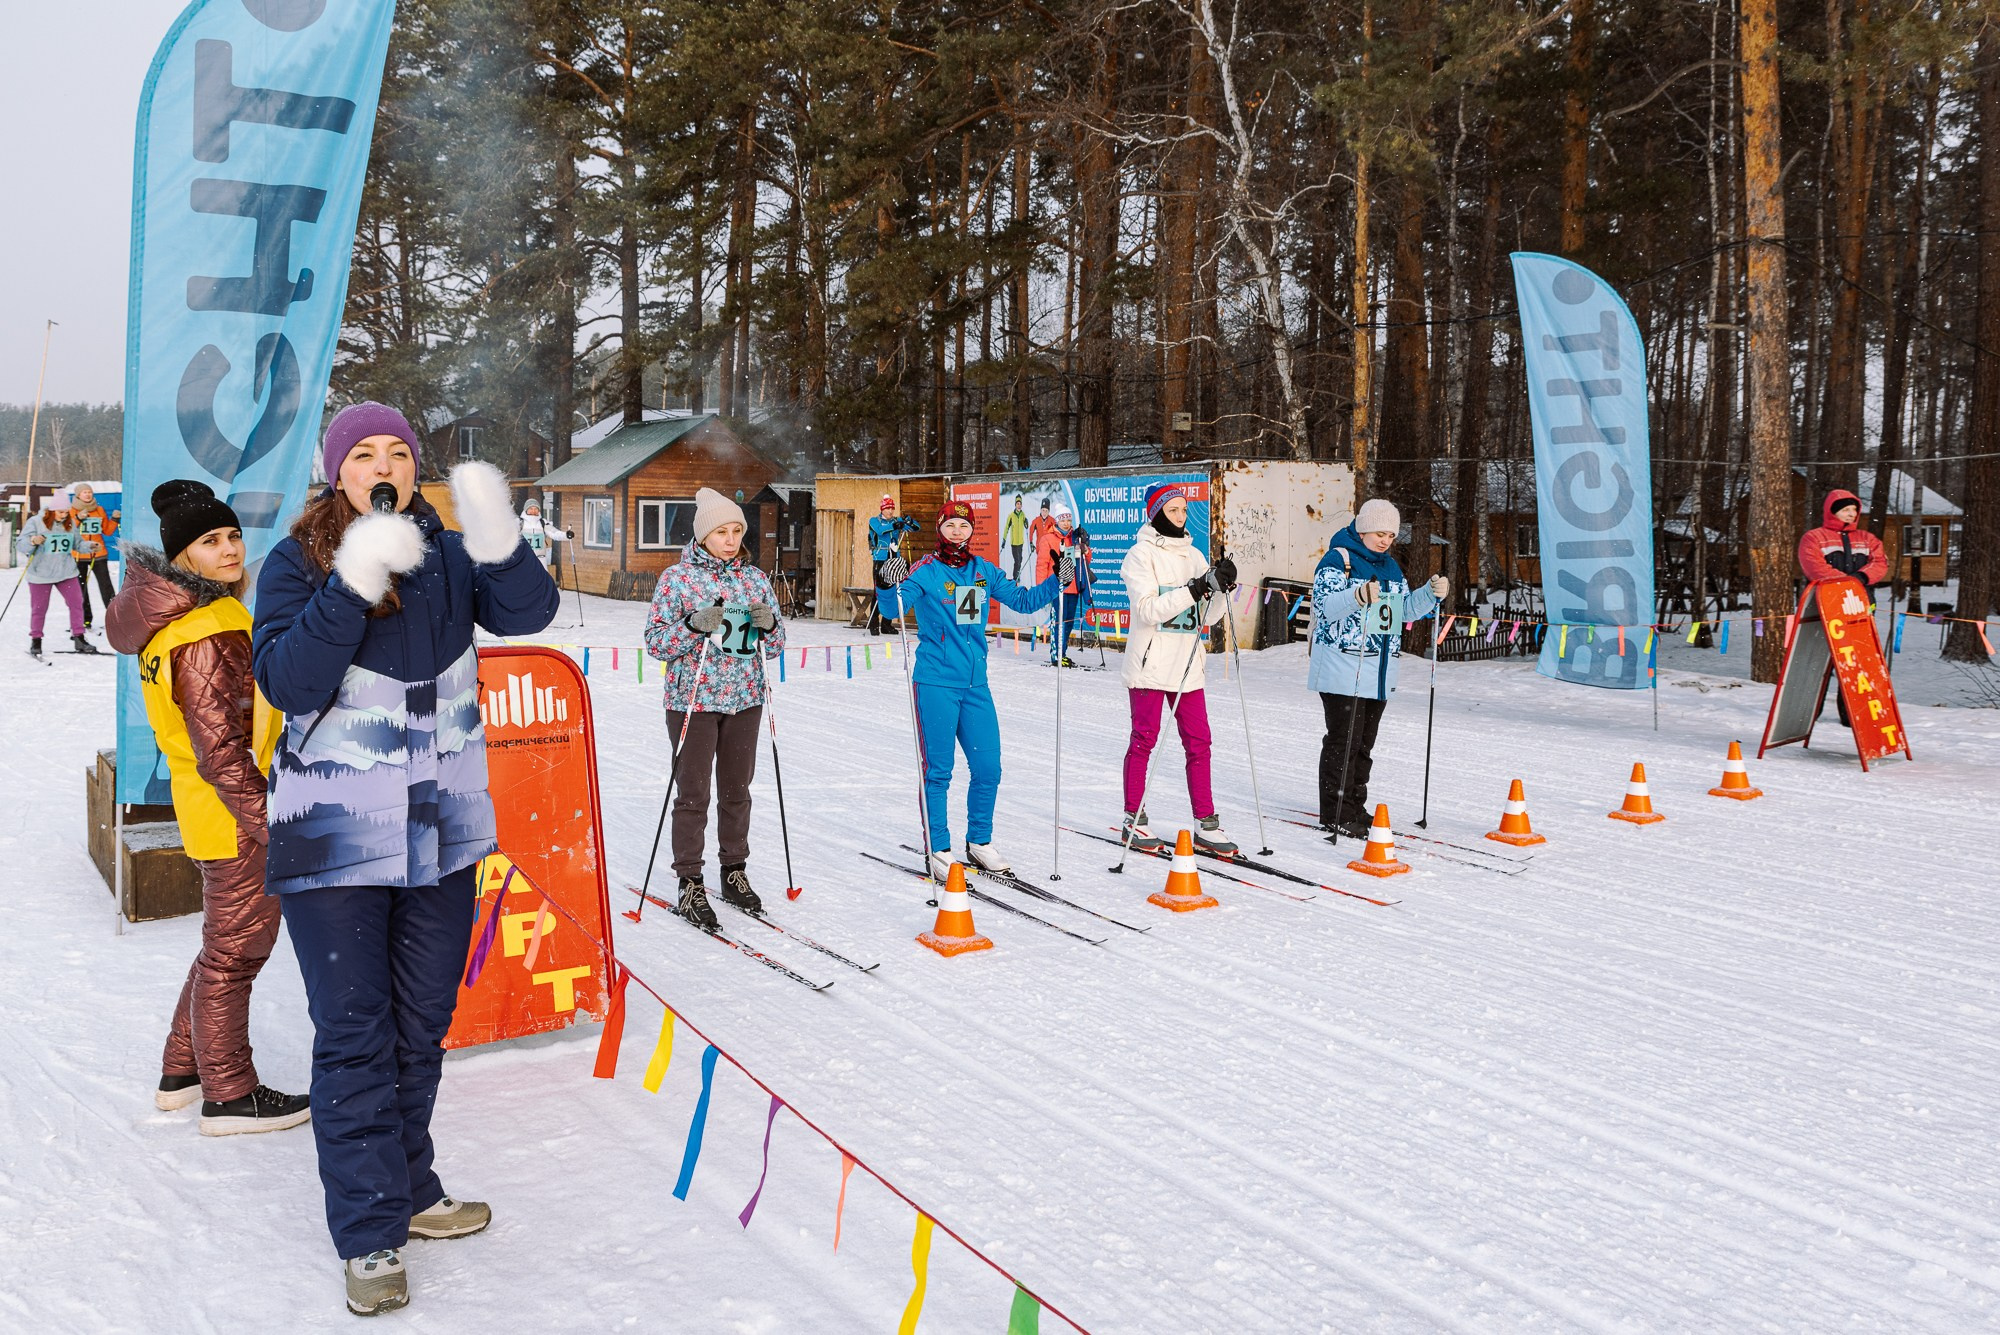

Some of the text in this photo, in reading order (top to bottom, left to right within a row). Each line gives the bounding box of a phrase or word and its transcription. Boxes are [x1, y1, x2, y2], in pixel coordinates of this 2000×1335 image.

[1085, 487, 1128, 503] ОБУЧЕНИЕ
[1131, 486, 1147, 503] ДЕТ
[1187, 485, 1200, 498] ЛЕТ
[1084, 508, 1125, 524] КАТАНИЮ
[1128, 508, 1139, 523] НА
[82, 522, 100, 534] 15
[51, 539, 70, 553] 19
[957, 588, 980, 621] 4
[1378, 604, 1394, 632] 9
[721, 618, 757, 655] 21
[1828, 618, 1898, 747] СТАРТ
[486, 733, 571, 750] кадемический
[978, 871, 1015, 889] SALOMON
[474, 853, 592, 1013] АРТ
